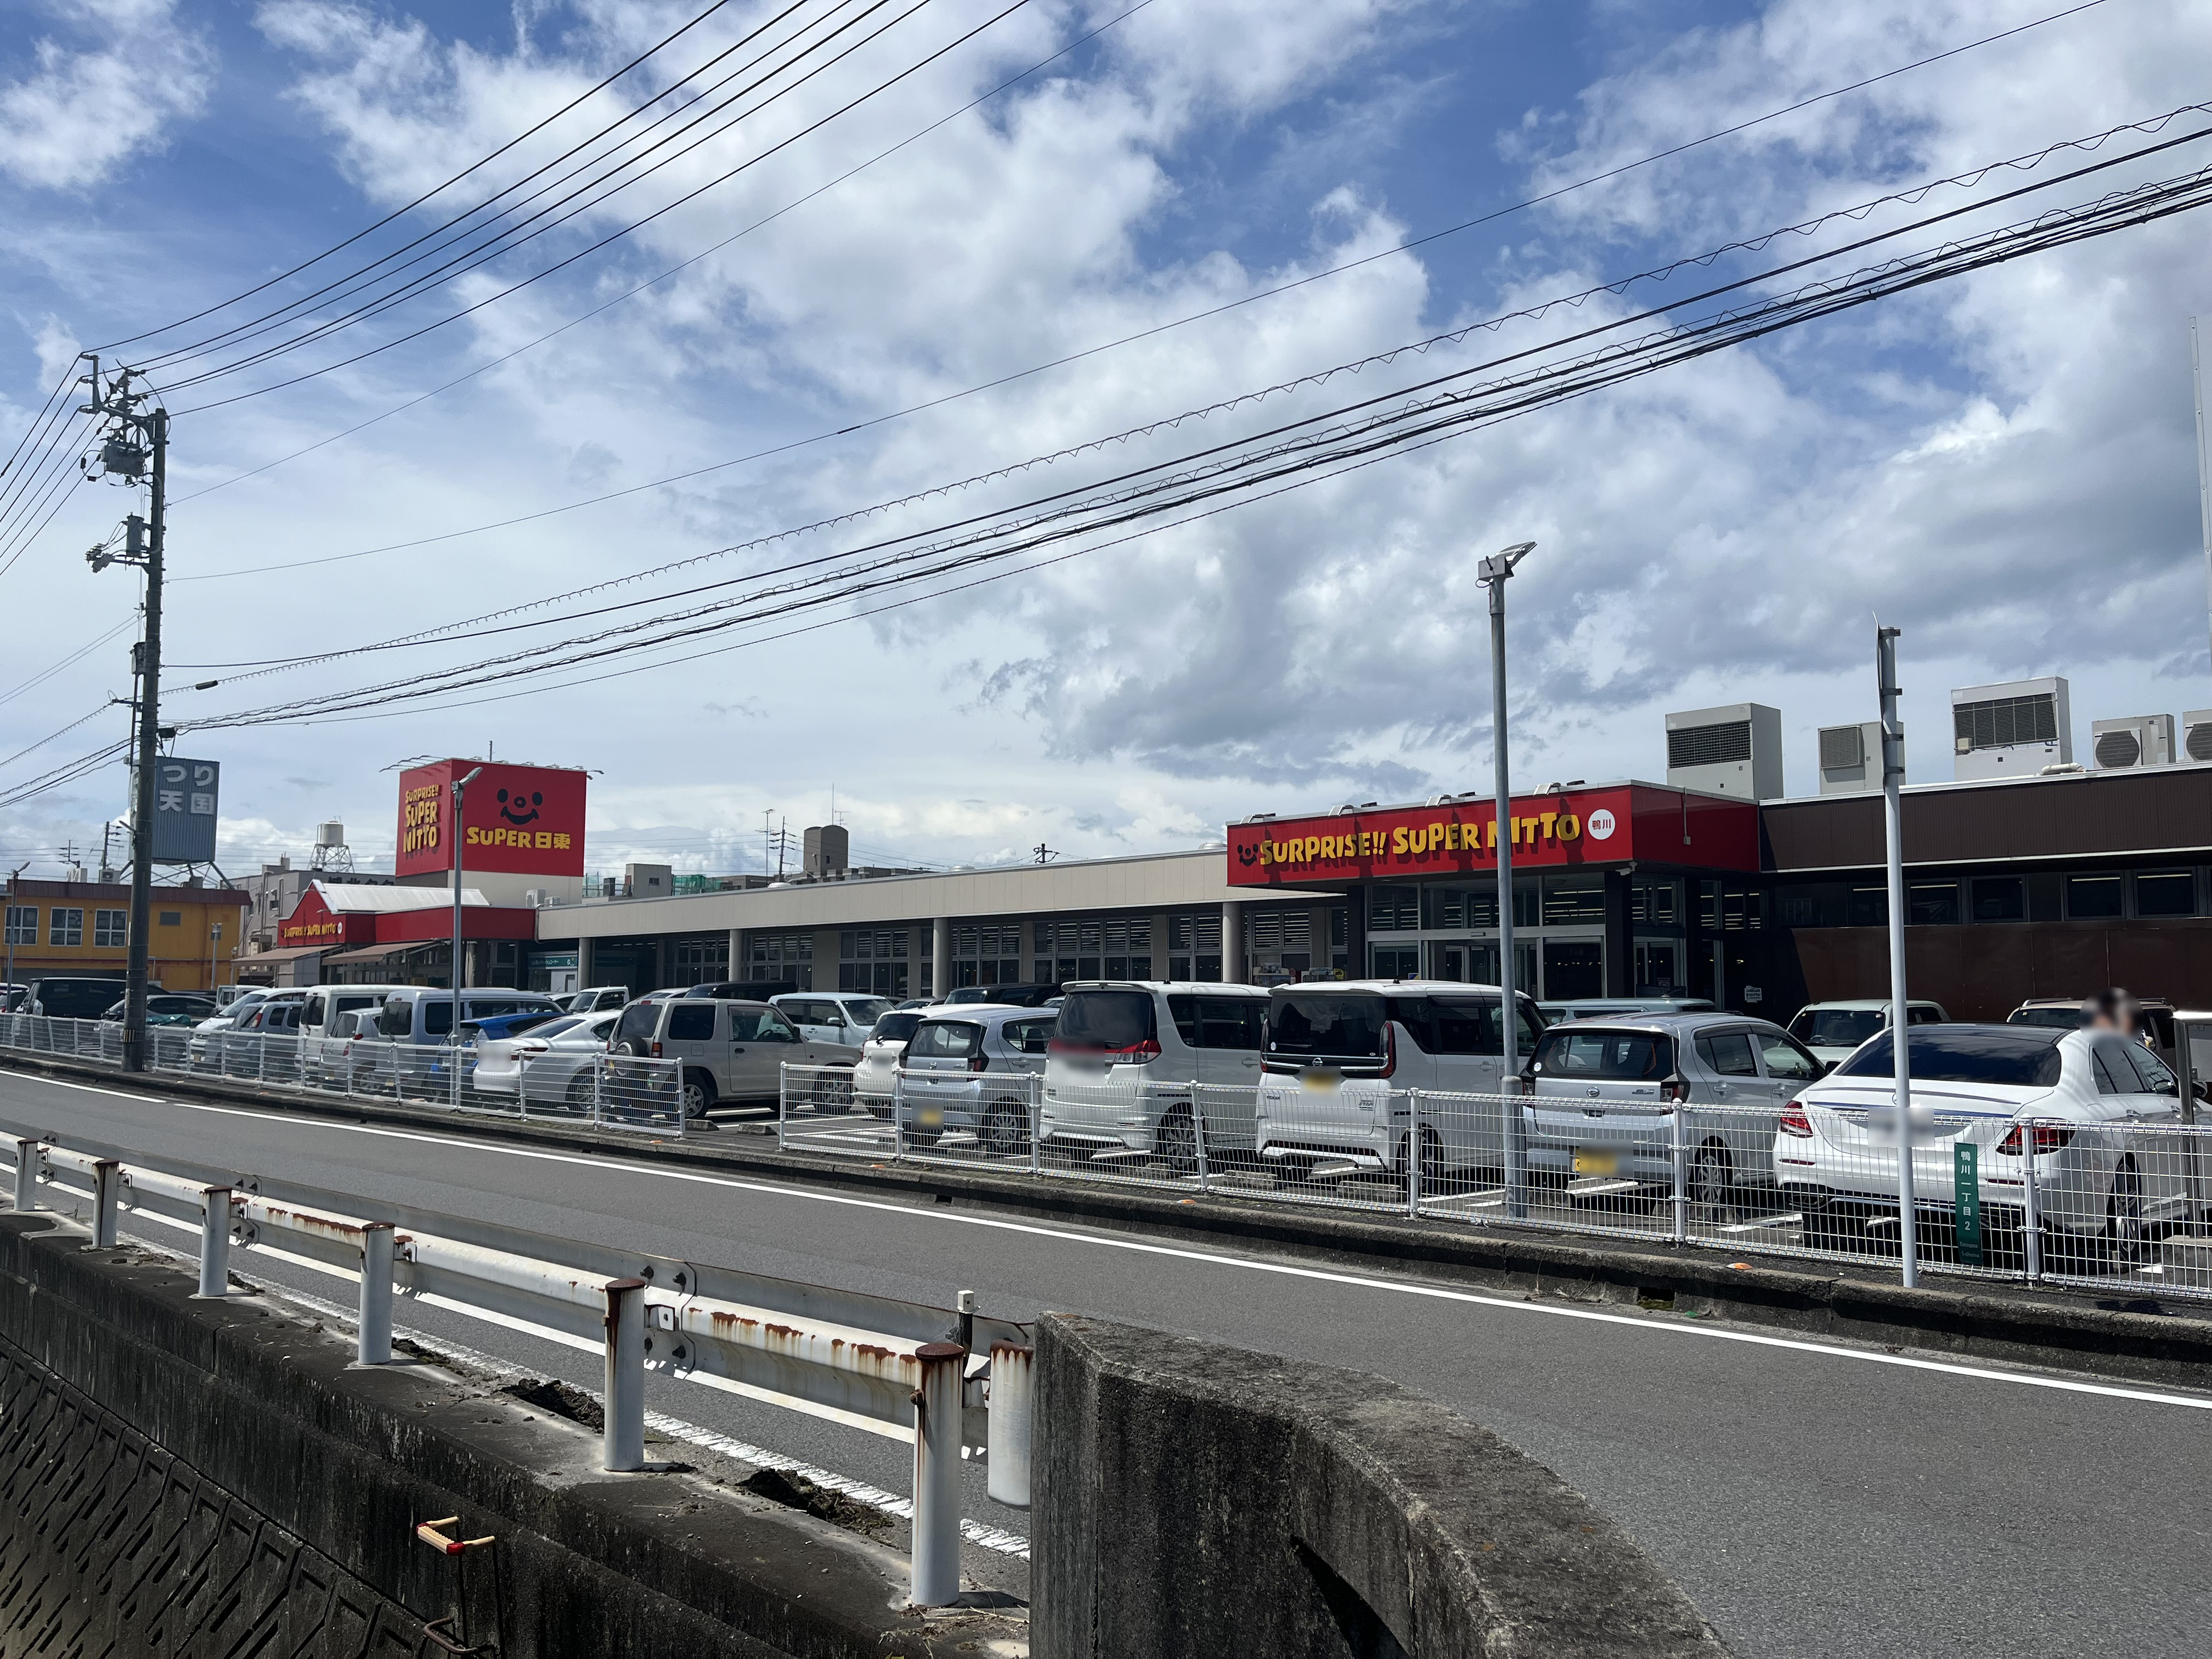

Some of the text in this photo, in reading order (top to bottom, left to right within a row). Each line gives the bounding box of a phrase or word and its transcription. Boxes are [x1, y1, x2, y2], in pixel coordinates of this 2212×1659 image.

[162, 765, 215, 787] つり
[158, 789, 215, 815] 天国
[405, 785, 439, 804] SURPRISE!!
[404, 801, 437, 827] SUPER
[1592, 819, 1611, 830] 鴨川
[403, 825, 437, 853] NITTO
[466, 827, 571, 850] SUPER 日東
[1260, 831, 1387, 865] SURPRISE!!
[1392, 822, 1481, 855] SUPER
